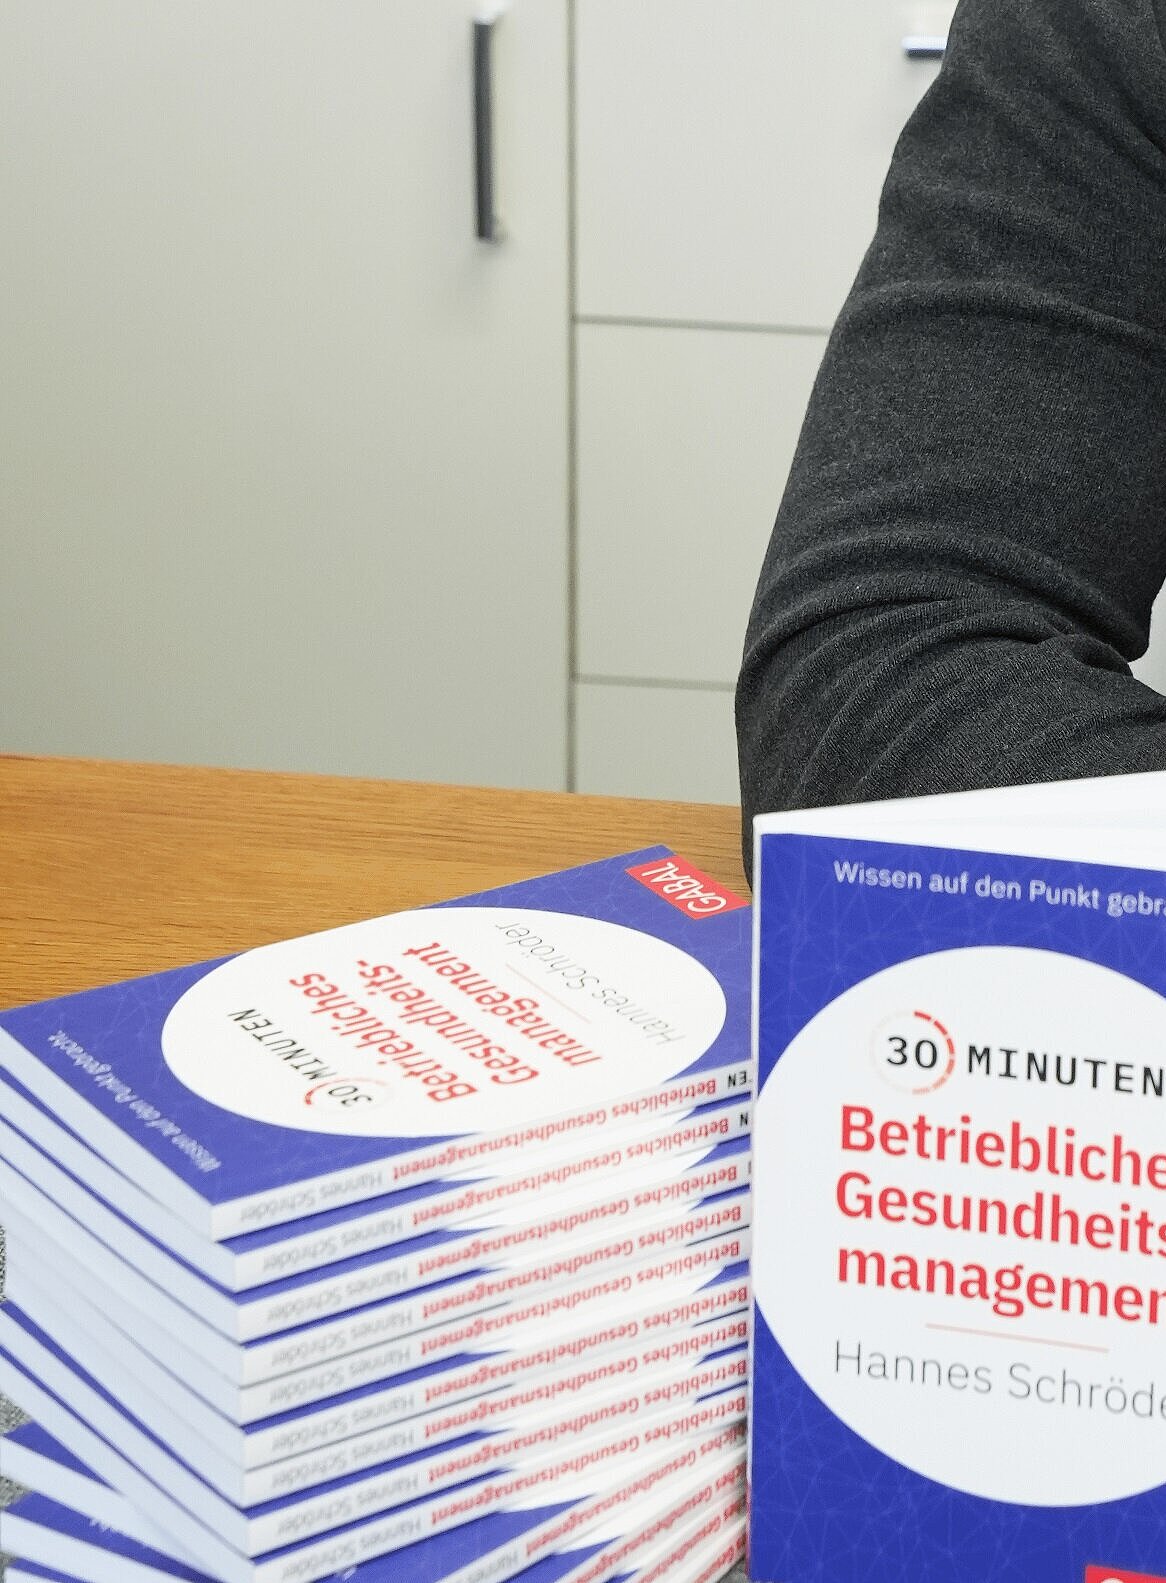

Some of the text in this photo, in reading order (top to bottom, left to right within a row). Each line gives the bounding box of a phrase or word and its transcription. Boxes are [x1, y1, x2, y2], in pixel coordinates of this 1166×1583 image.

[641, 862, 727, 913] GABAL
[833, 860, 922, 891] Wissen
[929, 872, 968, 896] auf
[975, 875, 1022, 900] den
[1029, 880, 1101, 910] Punkt
[401, 940, 603, 1068] management
[495, 921, 687, 1047] Hannes Schröder
[288, 971, 479, 1103] Betriebliches
[355, 958, 540, 1086] Gesundheits-
[227, 1007, 373, 1108] 30 MINUTEN
[886, 1035, 1165, 1098] 30 MINUTEN
[612, 1079, 717, 1115] Betriebliches
[393, 1109, 608, 1180] Gesundheitsmanagement
[626, 1119, 729, 1156] Betriebliches
[412, 1151, 622, 1225] Gesundheitsmanagement
[634, 1166, 738, 1204] Betriebliches
[418, 1200, 629, 1276] Gesundheitsmanagement
[638, 1205, 742, 1246] Betriebliches
[422, 1239, 634, 1318] Gesundheitsmanagement
[636, 1241, 741, 1280] Betriebliches
[421, 1276, 632, 1355] Gesundheitsmanagement
[643, 1286, 749, 1326] Betriebliches
[834, 1339, 993, 1395] Hannes
